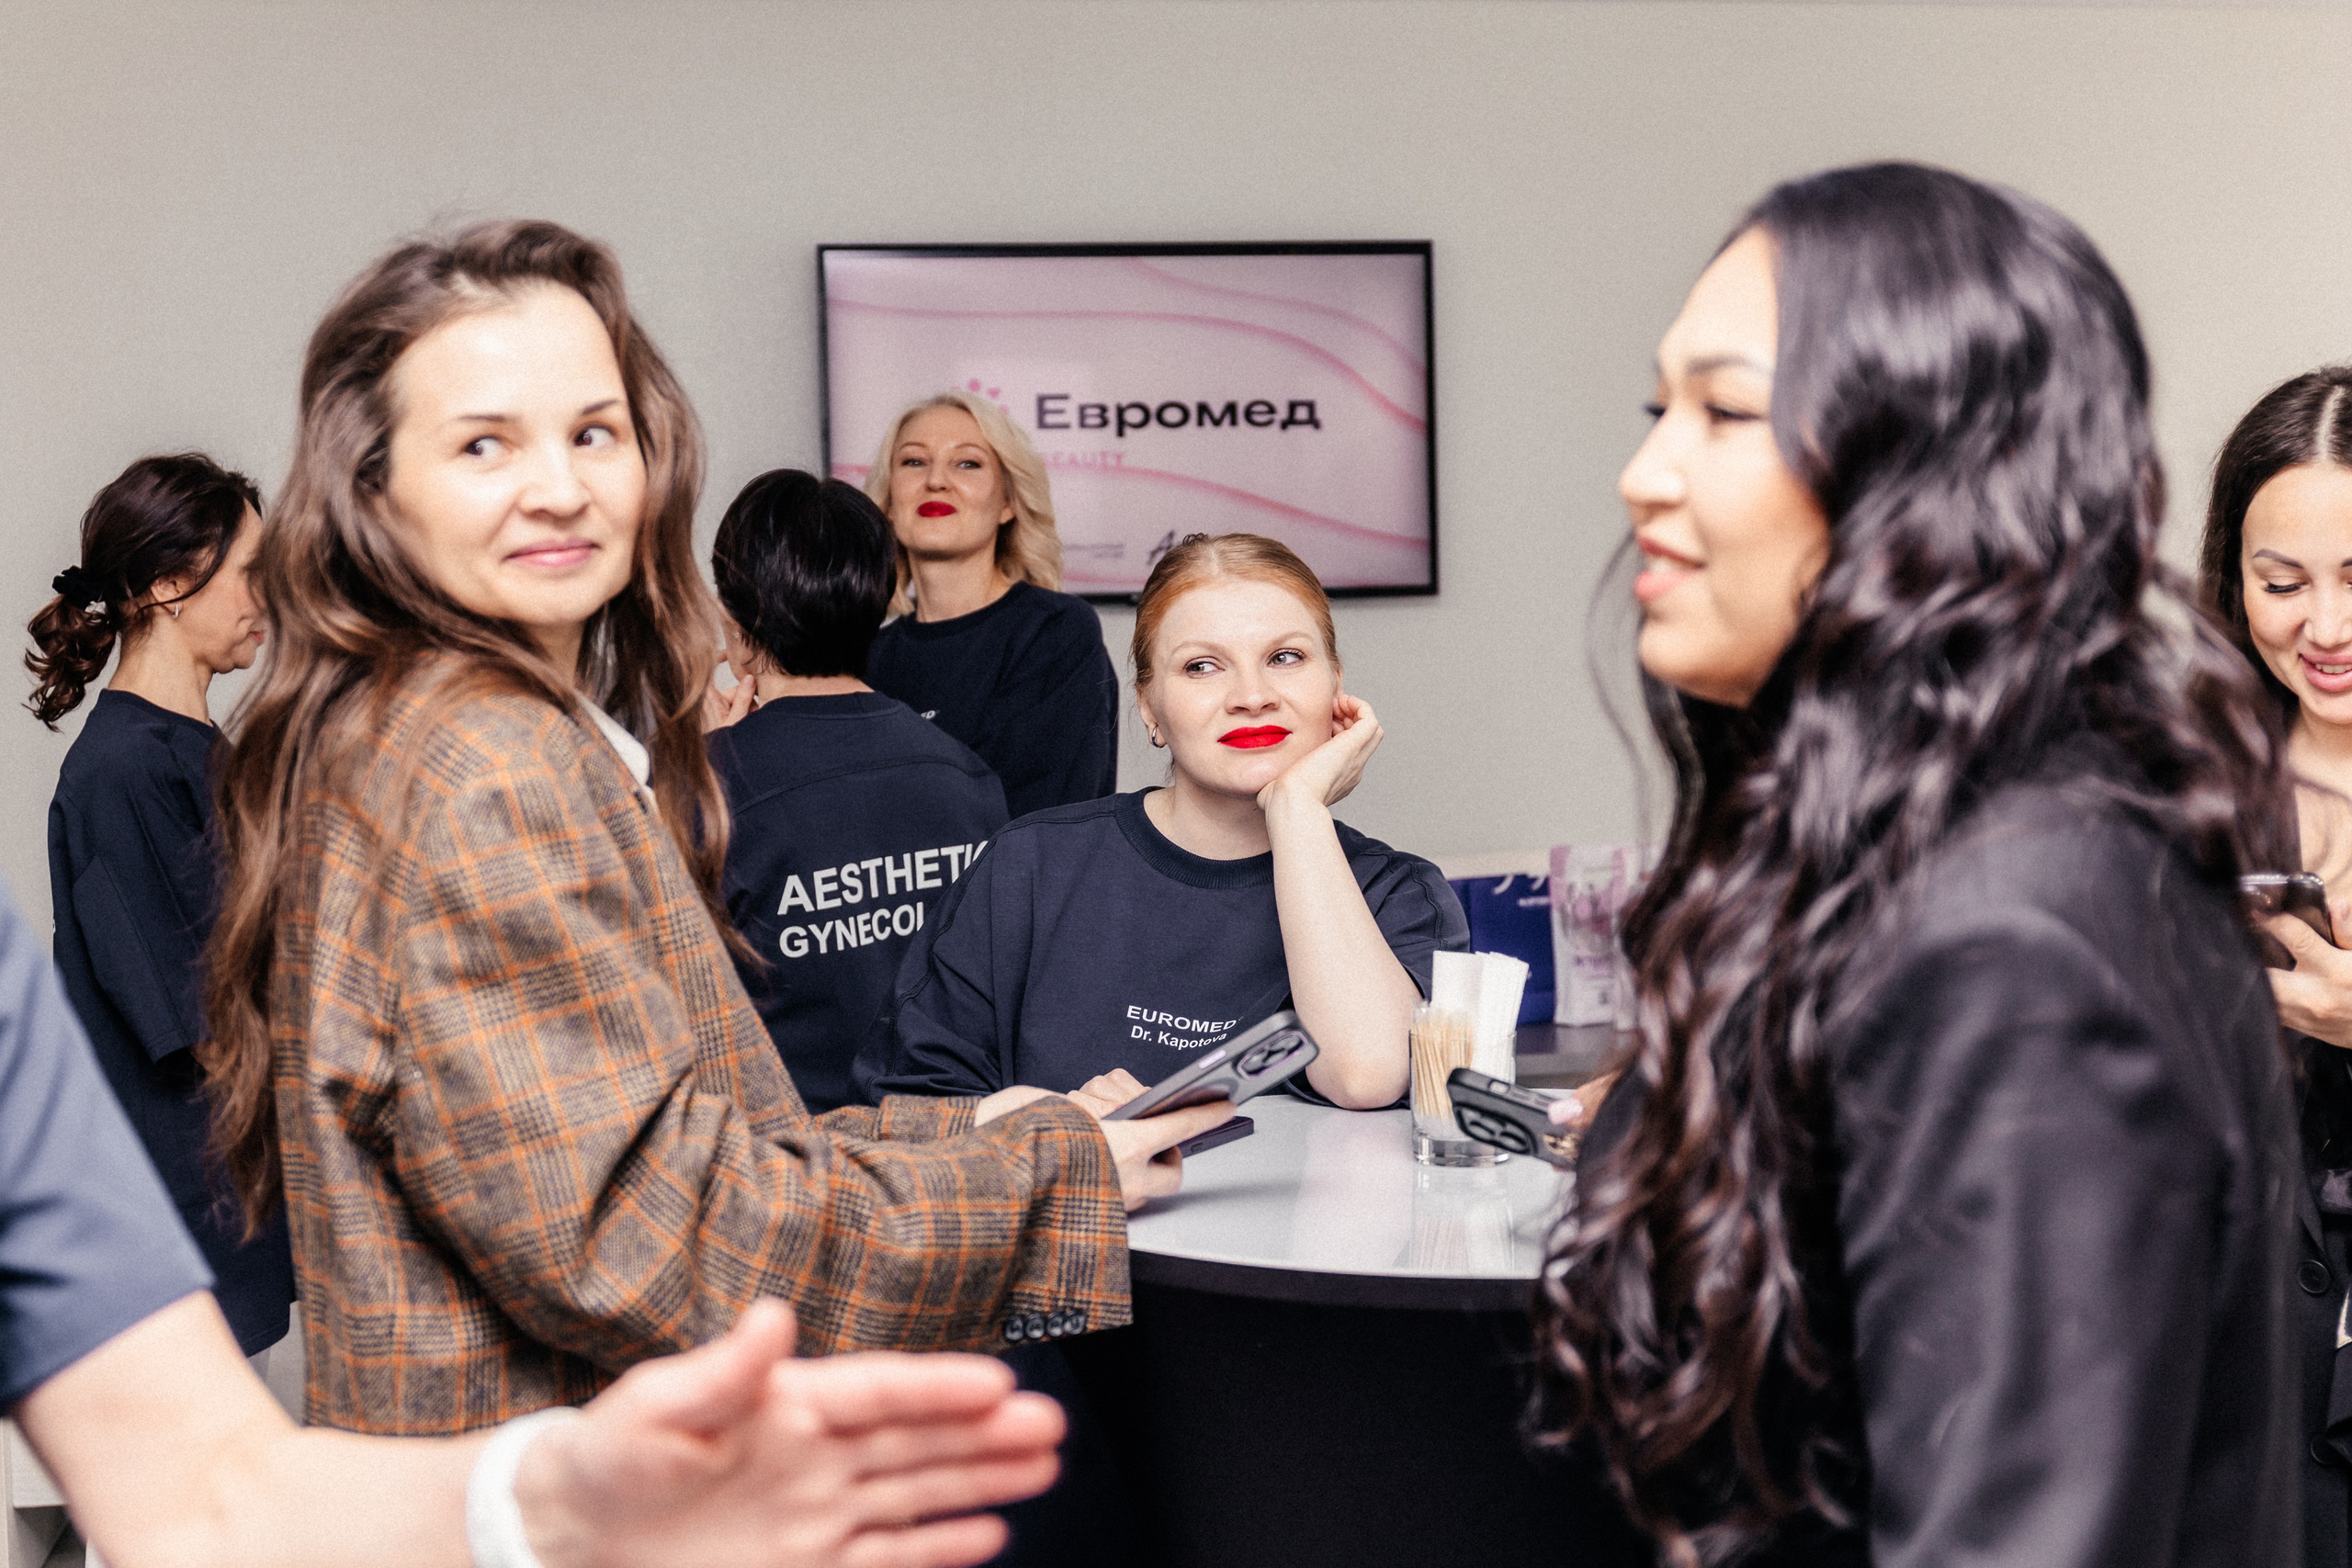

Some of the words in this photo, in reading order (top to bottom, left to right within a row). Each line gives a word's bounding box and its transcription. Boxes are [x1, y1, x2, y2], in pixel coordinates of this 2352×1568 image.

[1035, 393, 1321, 437] Евромед
[1126, 1005, 1237, 1032] EUROMED
[1130, 1025, 1152, 1042] Dr.
[1158, 1031, 1227, 1050] Kapotova
